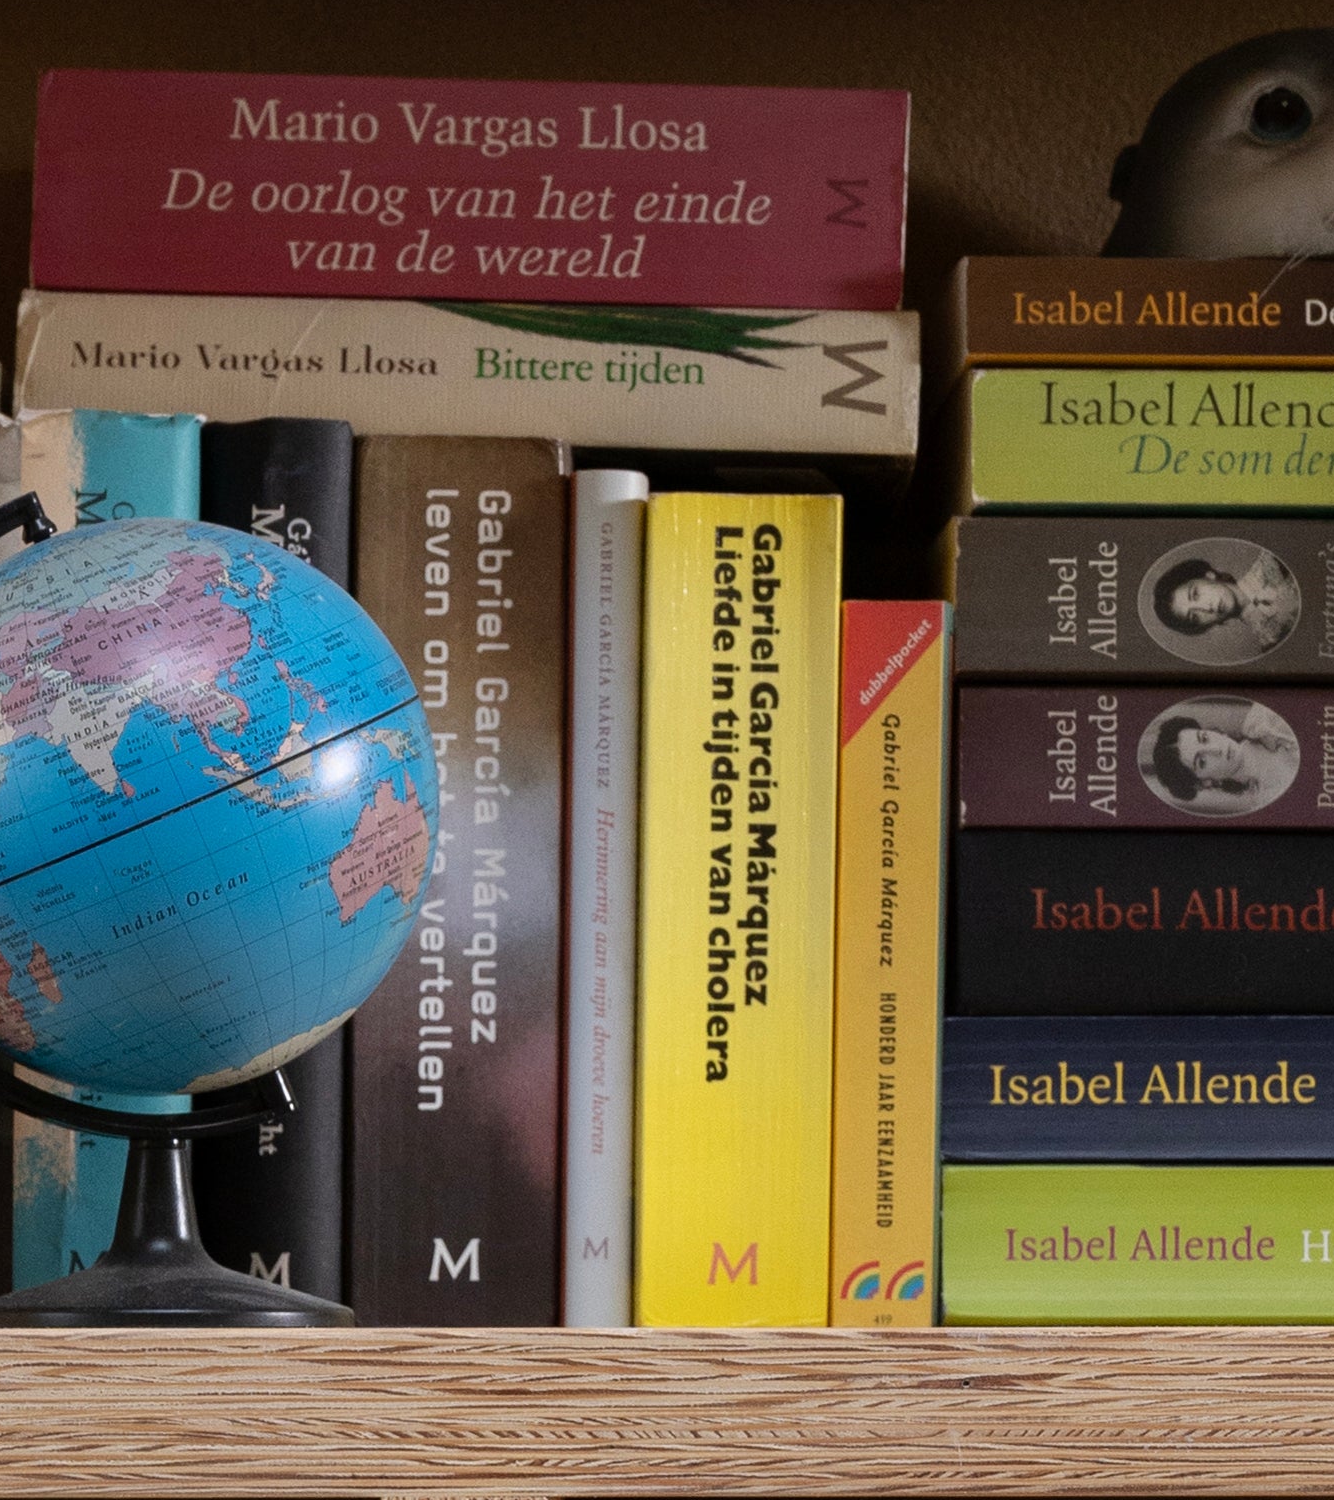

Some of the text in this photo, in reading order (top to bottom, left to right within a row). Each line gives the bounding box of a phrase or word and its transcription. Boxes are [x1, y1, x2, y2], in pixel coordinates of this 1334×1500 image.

[229, 98, 710, 158] Mario Vargas Llosa
[162, 167, 772, 228] De oorlog van het einde
[287, 229, 647, 281] van de wereld
[1013, 291, 1128, 327] Isabel
[1136, 293, 1282, 329] Allende
[751, 523, 783, 674] Gabriel
[97, 616, 162, 652] CHINA
[858, 617, 933, 708] dubbelpocket
[63, 718, 113, 744] INDIA
[703, 526, 744, 1084] Liefde in tijden van cholera
[348, 844, 417, 885] AUSTRALIA
[111, 870, 252, 941] Indian Ocean
[737, 824, 777, 1006] Márquez
[1031, 888, 1163, 932] Isabel
[989, 1062, 1125, 1106] Isabel
[1139, 1062, 1317, 1106] Allende
